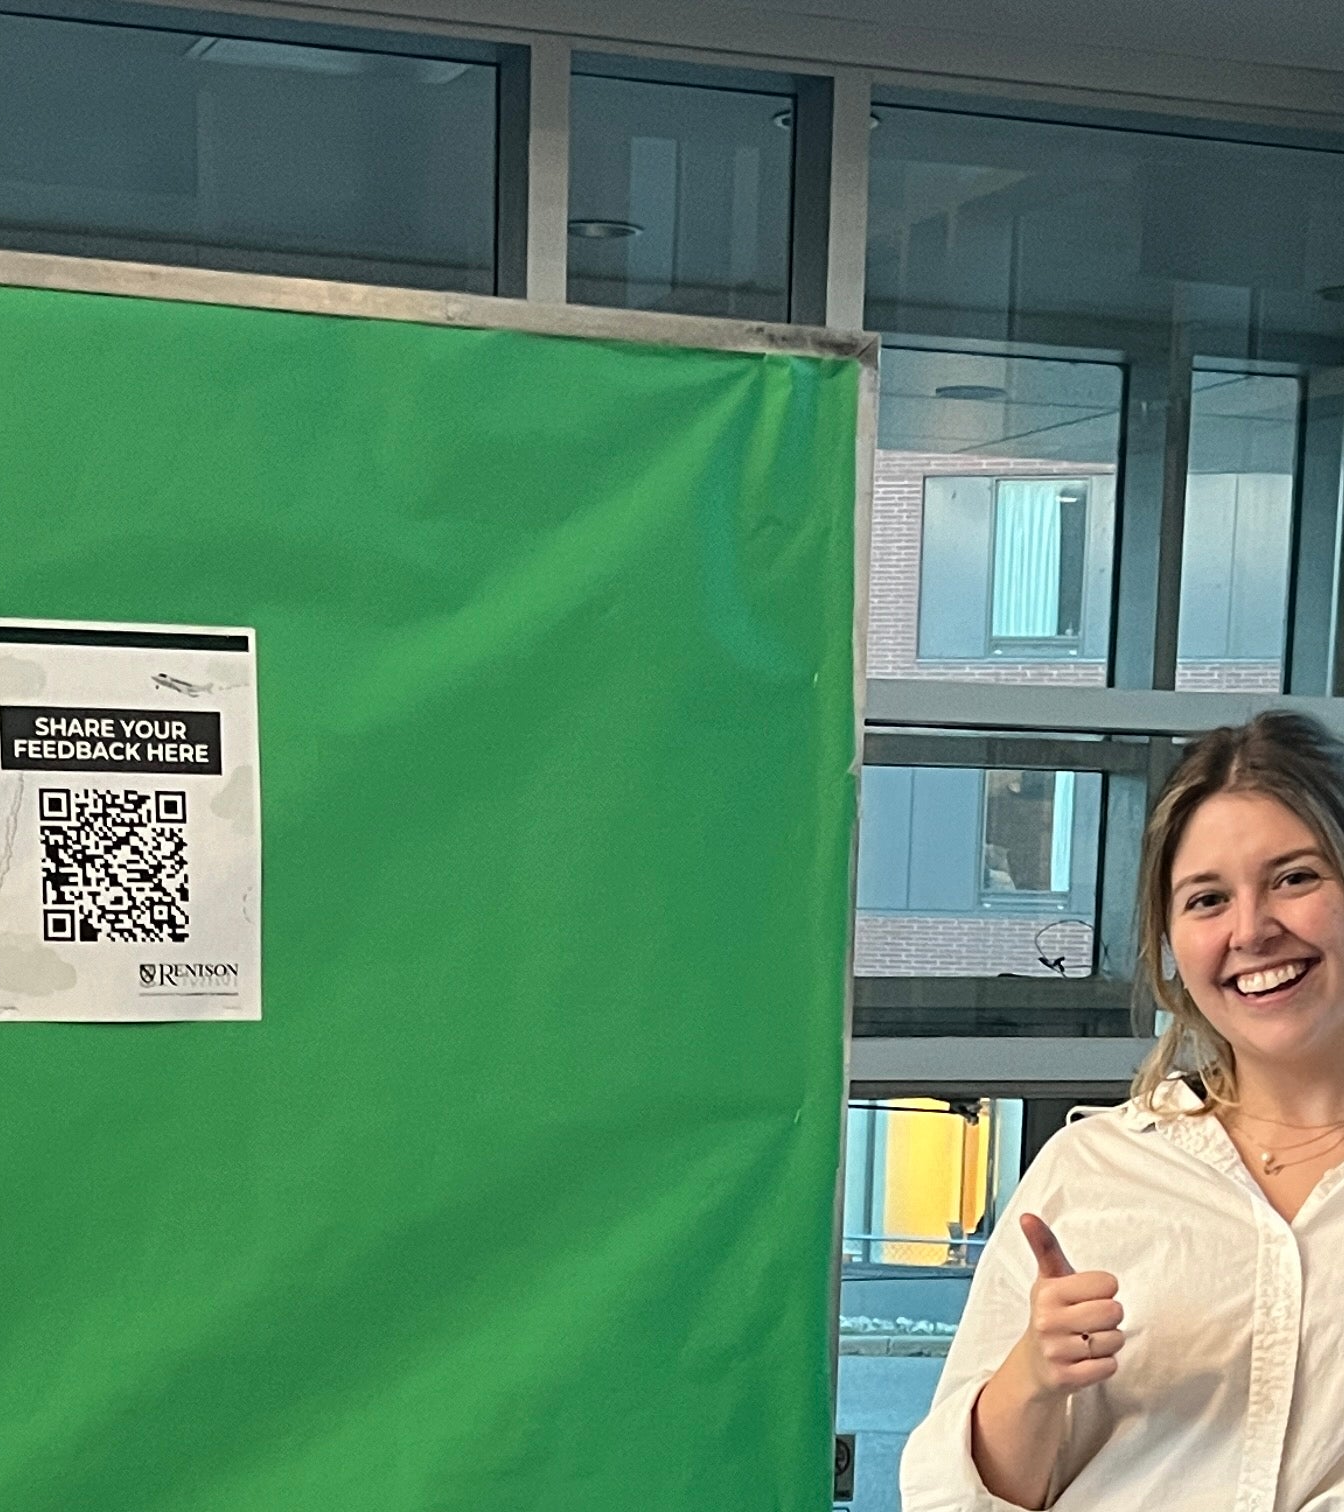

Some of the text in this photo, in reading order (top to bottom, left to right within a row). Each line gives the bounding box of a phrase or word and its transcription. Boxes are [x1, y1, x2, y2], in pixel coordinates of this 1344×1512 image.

[35, 717, 188, 740] SHARE YOUR
[13, 738, 210, 763] FEEDBACK HERE
[159, 962, 240, 988] RENISON
